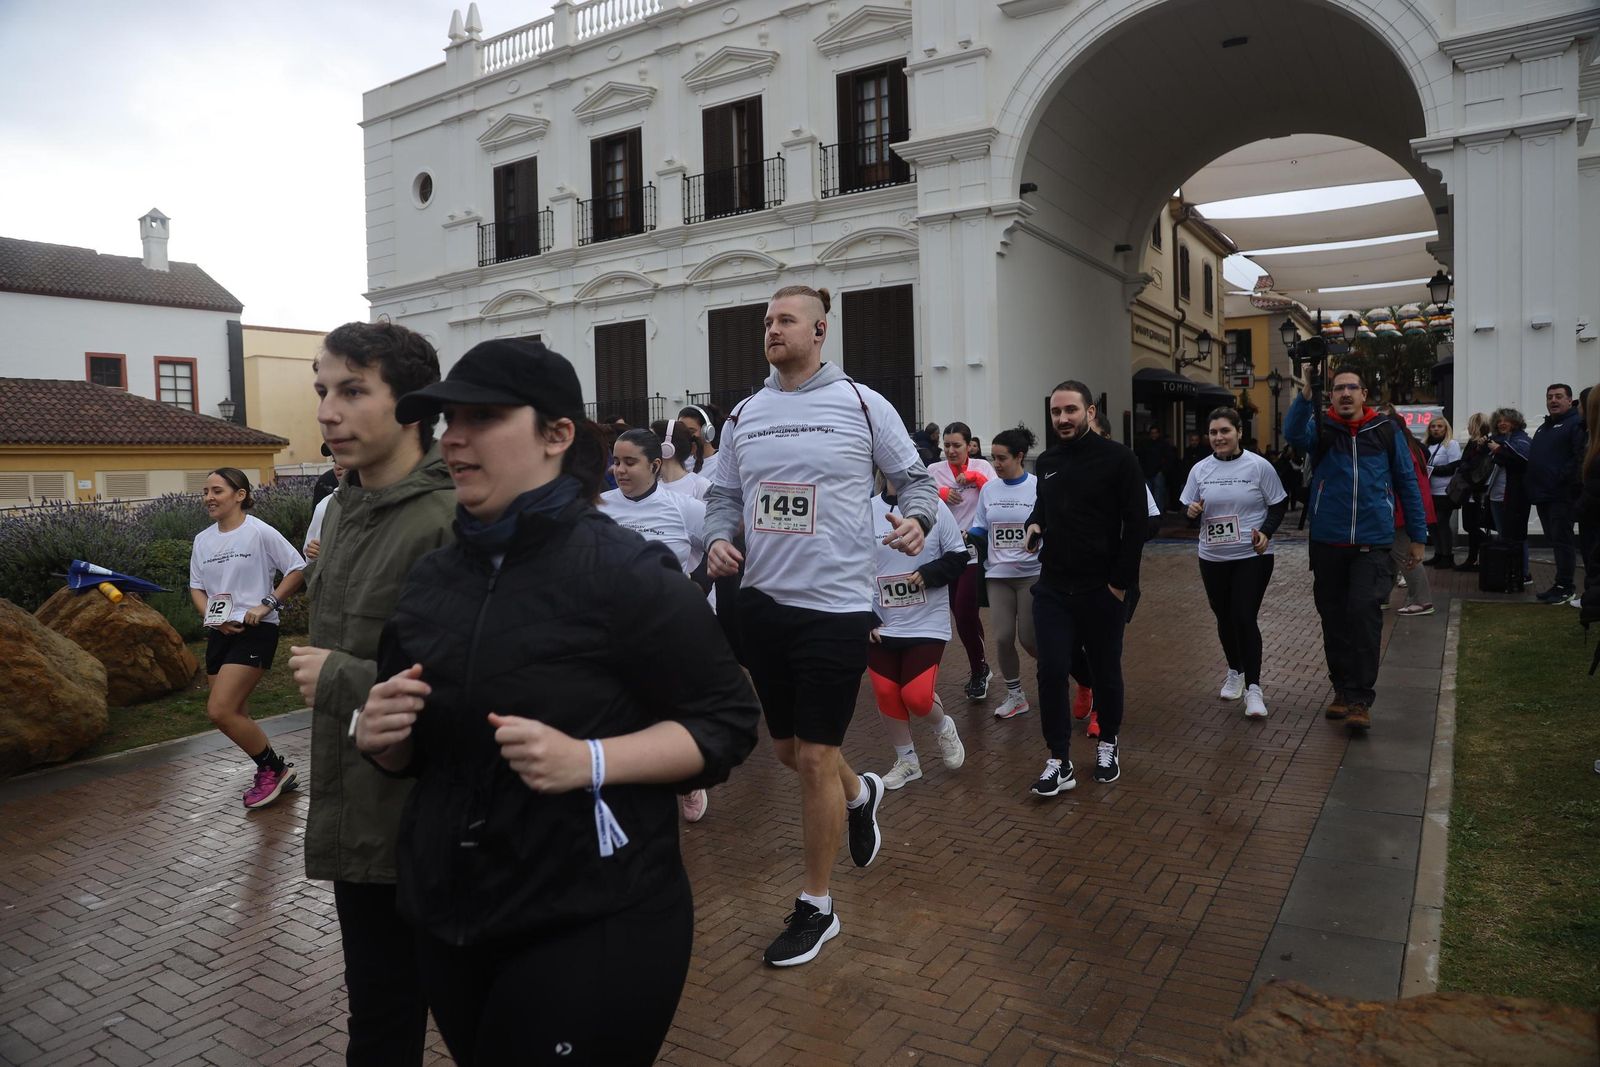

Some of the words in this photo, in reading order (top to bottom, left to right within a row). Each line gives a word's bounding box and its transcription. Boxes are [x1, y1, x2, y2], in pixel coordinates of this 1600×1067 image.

[760, 495, 809, 517] 149
[995, 529, 1024, 540] 203
[1208, 522, 1234, 536] 231
[883, 582, 920, 597] 100
[209, 601, 226, 614] 42
